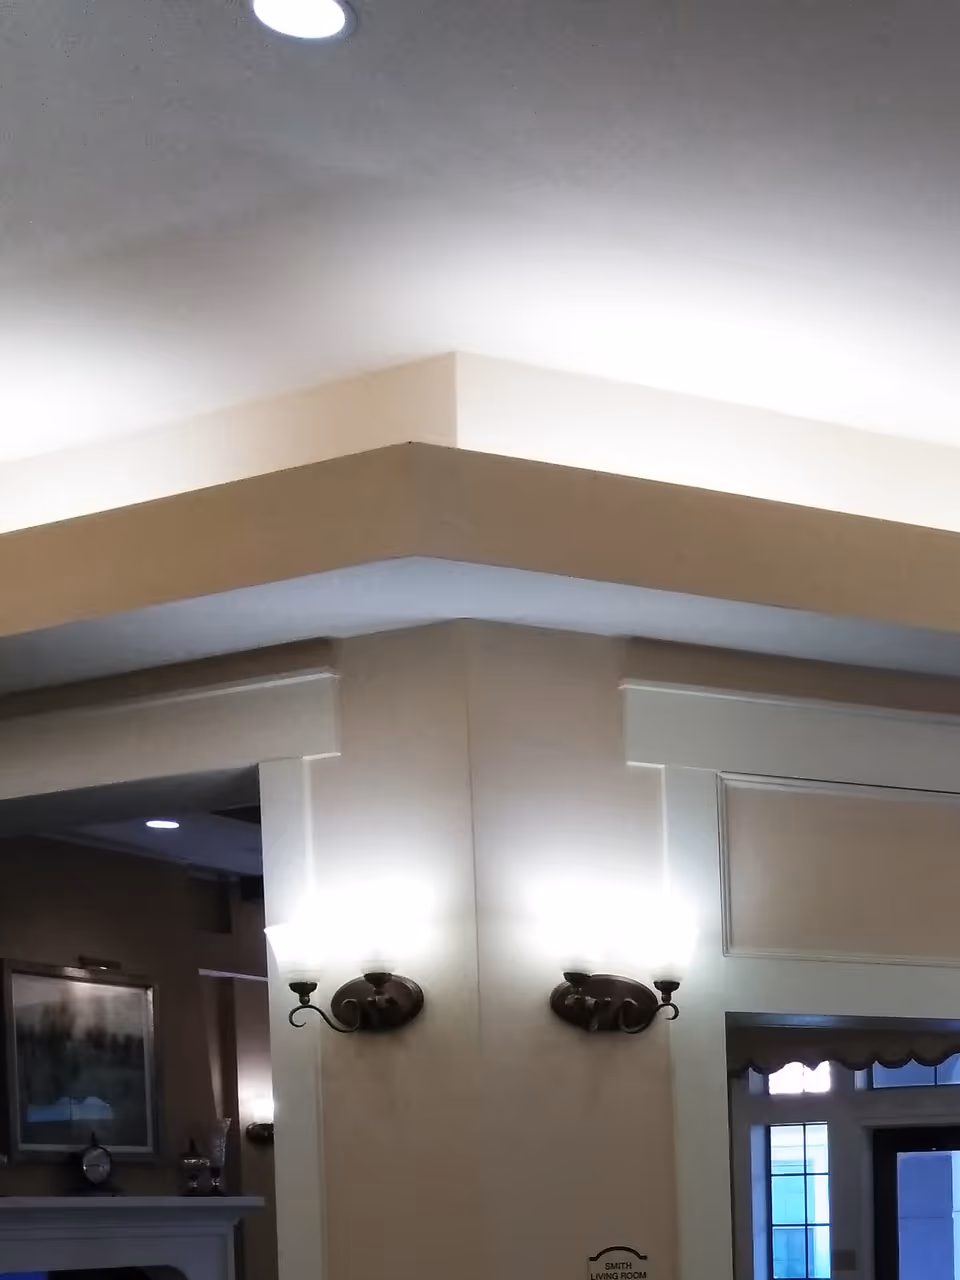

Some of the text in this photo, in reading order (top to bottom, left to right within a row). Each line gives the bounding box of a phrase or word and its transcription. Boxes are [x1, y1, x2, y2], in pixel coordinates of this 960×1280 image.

[604, 1262, 632, 1270] SMITH
[591, 1271, 646, 1280] LIVING ROOM
